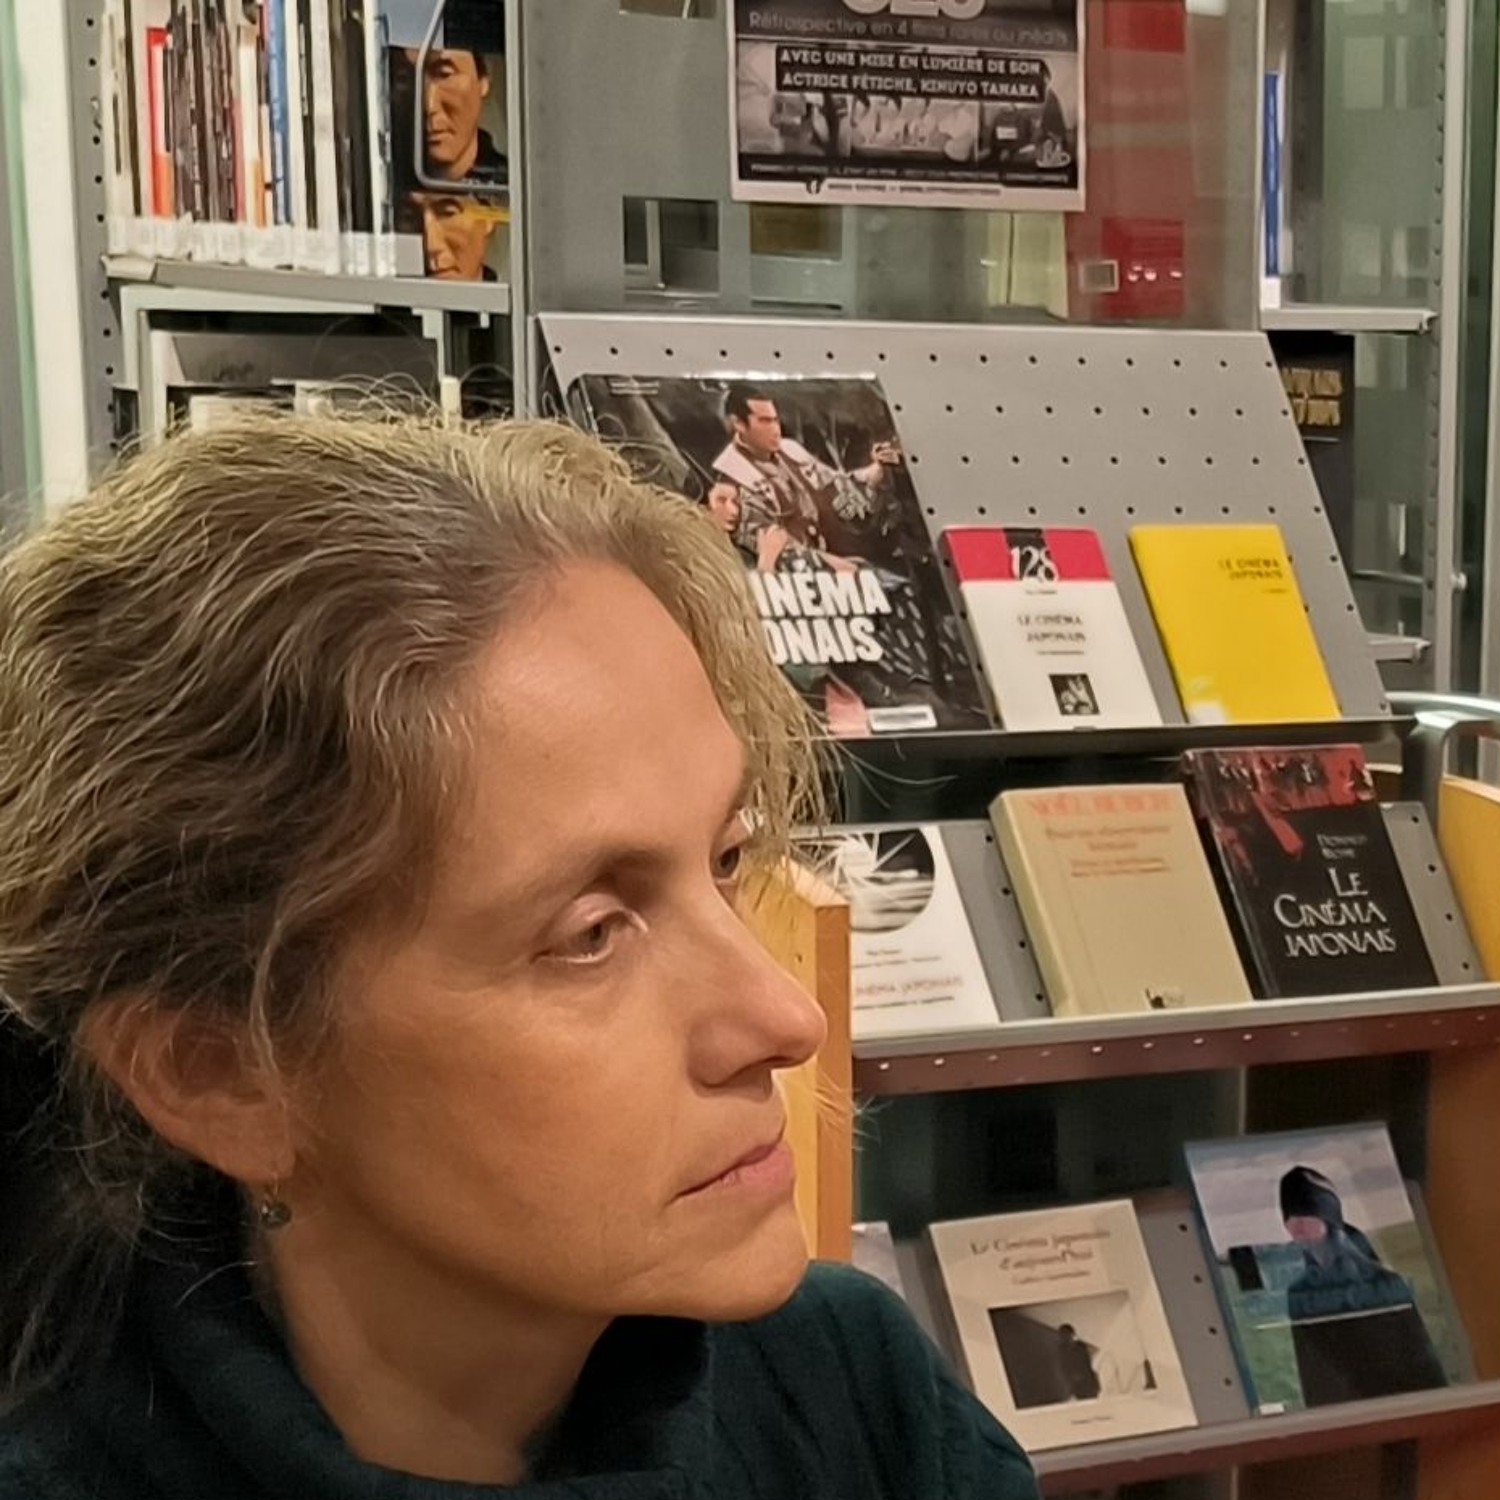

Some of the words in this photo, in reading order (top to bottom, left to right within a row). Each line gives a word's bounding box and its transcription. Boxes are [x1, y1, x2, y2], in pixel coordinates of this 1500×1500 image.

[780, 50, 822, 64] AVEC
[825, 51, 854, 66] UNE
[860, 53, 895, 68] MISE
[899, 55, 919, 69] EN
[922, 56, 984, 73] LUMIÈRE
[987, 59, 1006, 74] DE
[1009, 60, 1041, 75] SON
[782, 72, 848, 88] ACTRICE
[853, 73, 917, 93] FÉTICHE,
[921, 79, 978, 95] KINUYO
[981, 81, 1039, 97] TANAKA
[1010, 546, 1060, 583] 128
[749, 566, 893, 618] INÉMA
[761, 616, 884, 665] ONAIS
[1328, 867, 1368, 897] LE
[1274, 893, 1387, 928] CINÉMA
[1285, 928, 1396, 957] JAPONAIS
